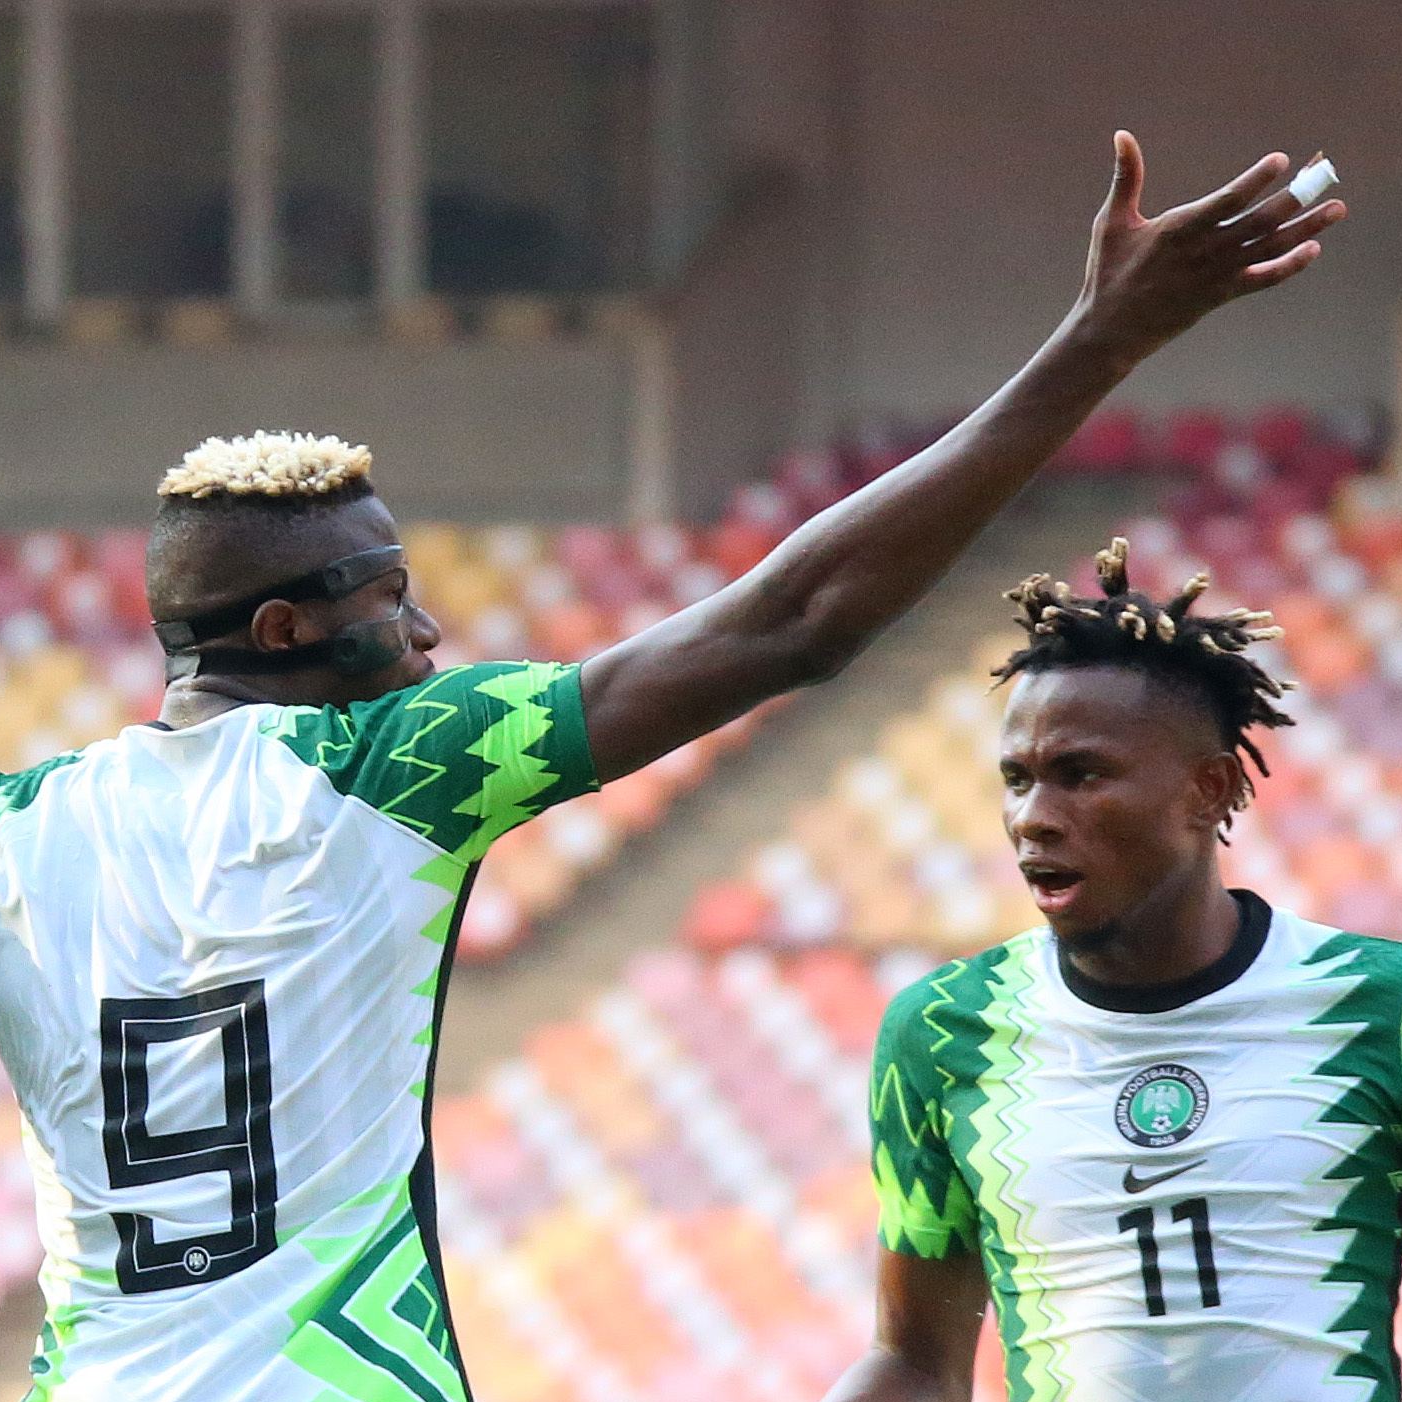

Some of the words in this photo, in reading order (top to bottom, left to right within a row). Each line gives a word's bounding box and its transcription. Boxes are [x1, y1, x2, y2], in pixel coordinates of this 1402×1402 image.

[101, 980, 277, 1293] 9
[1123, 1067, 1180, 1098] FOOTBALL
[1116, 1197, 1221, 1316] 11
